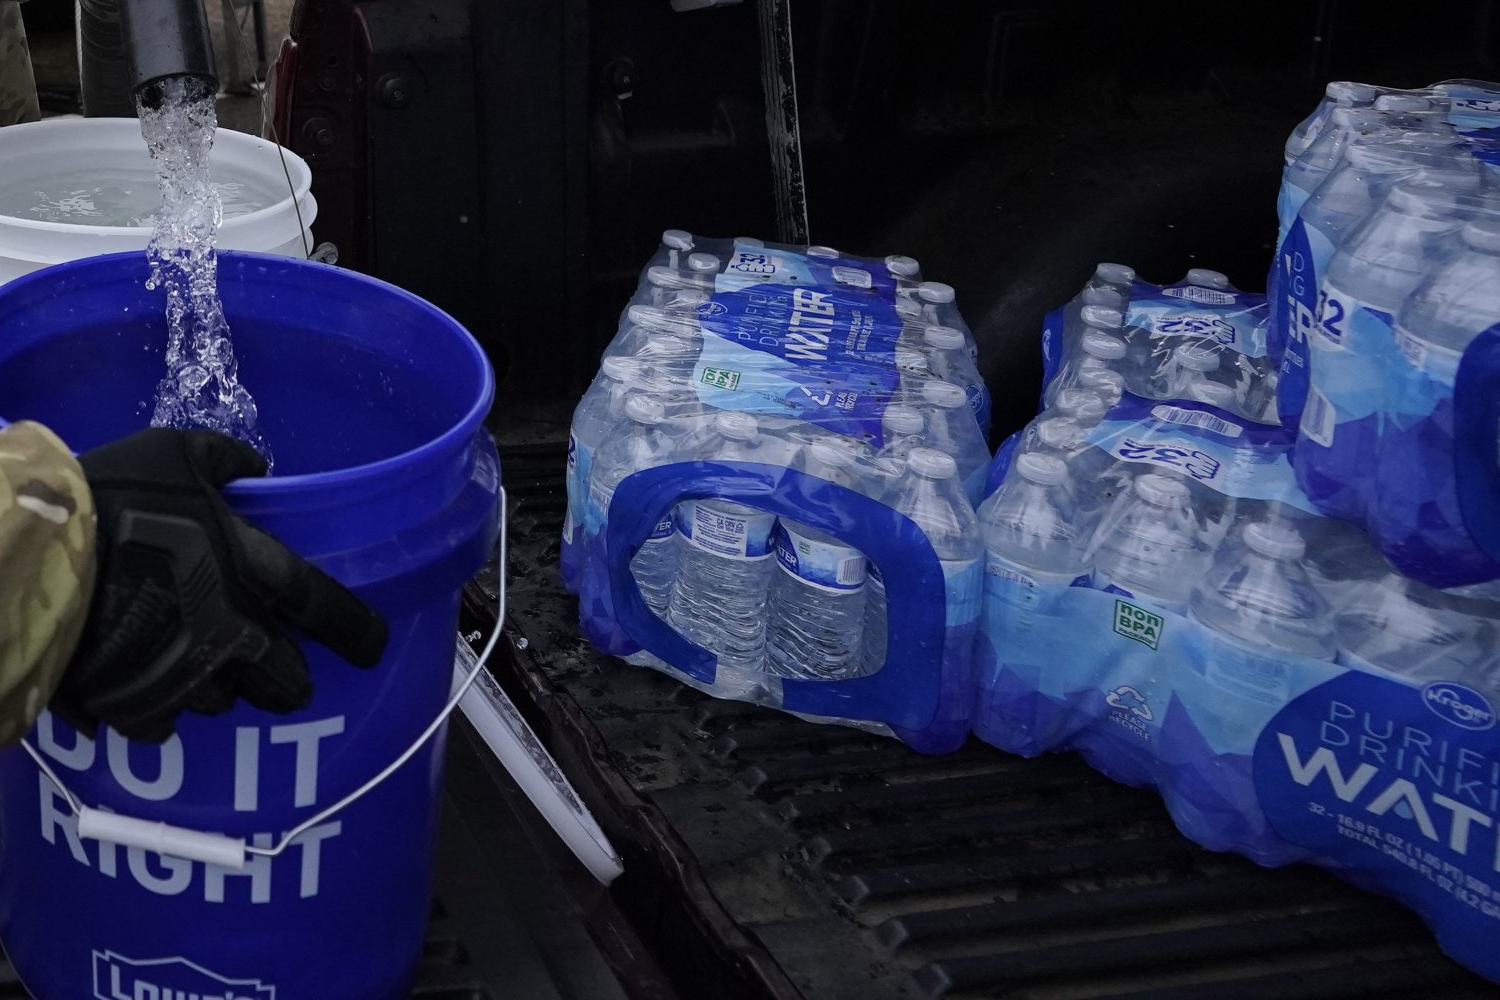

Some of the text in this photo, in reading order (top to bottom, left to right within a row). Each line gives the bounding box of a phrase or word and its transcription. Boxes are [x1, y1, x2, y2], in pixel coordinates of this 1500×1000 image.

[785, 287, 835, 361] WATER
[1119, 441, 1190, 466] 32
[1118, 616, 1158, 640] BPA
[1119, 603, 1160, 628] non
[1426, 687, 1491, 722] Kroger
[1108, 715, 1152, 743] RECYCLE
[1112, 710, 1149, 732] PLEASE
[234, 715, 346, 812] IT
[1308, 801, 1326, 817] 32
[1337, 813, 1365, 833] 16.9
[1366, 824, 1383, 841] FL
[39, 770, 343, 904] RIGHT
[1336, 824, 1381, 851] TOTAL
